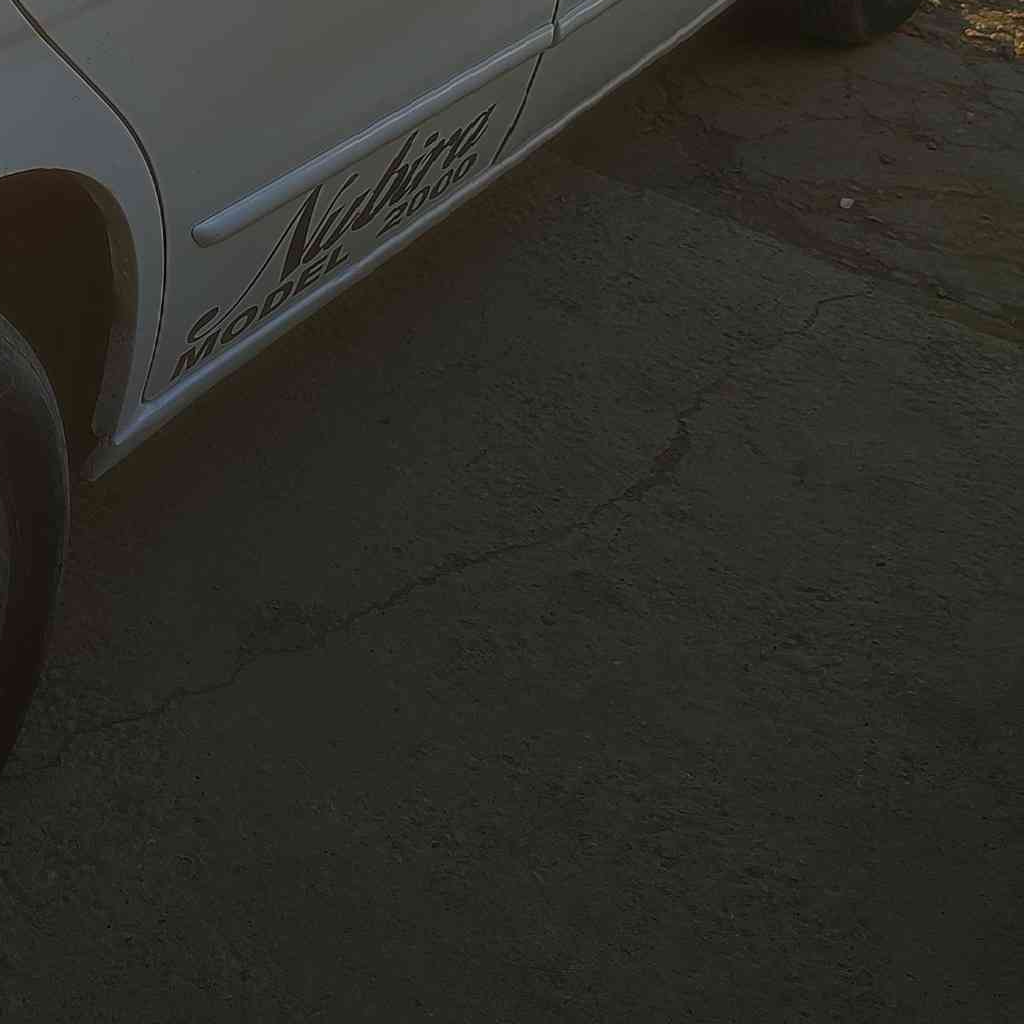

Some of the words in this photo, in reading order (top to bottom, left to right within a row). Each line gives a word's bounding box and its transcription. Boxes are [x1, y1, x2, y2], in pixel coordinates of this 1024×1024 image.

[169, 245, 350, 382] MODEL
[375, 153, 478, 238] 2000
[186, 103, 497, 344] Nubira
